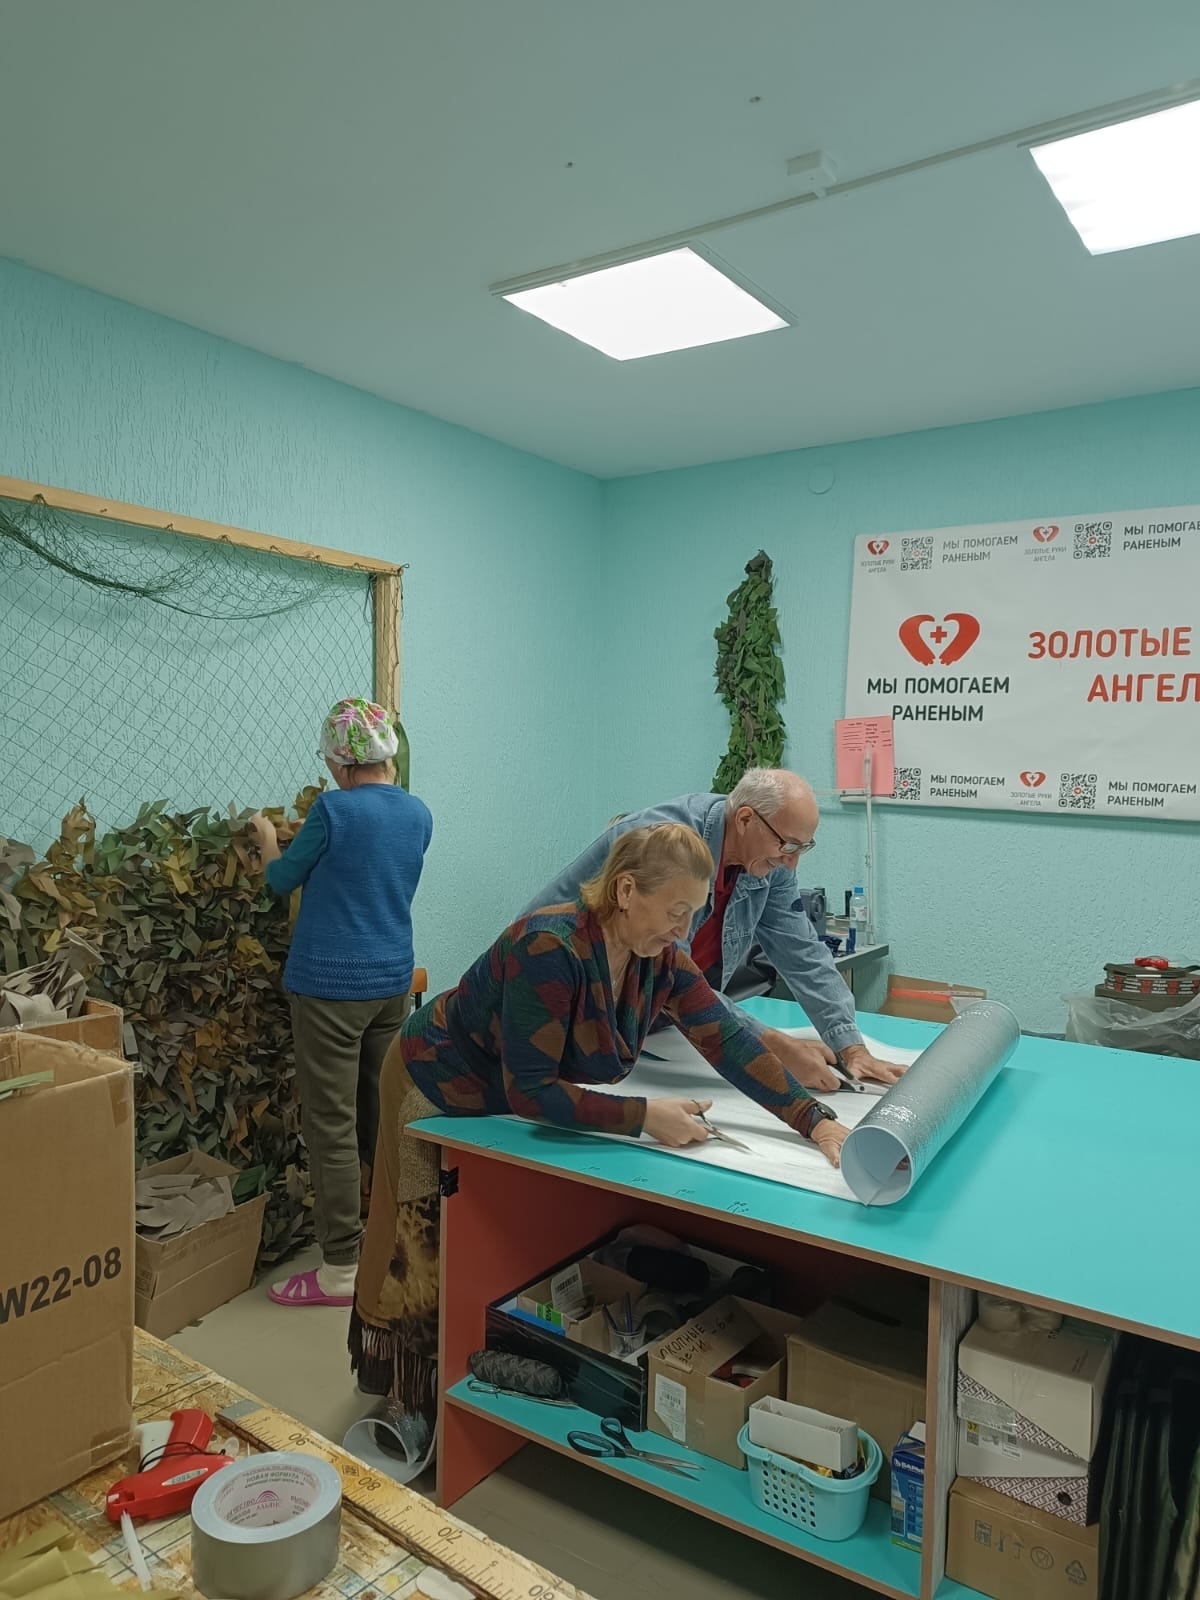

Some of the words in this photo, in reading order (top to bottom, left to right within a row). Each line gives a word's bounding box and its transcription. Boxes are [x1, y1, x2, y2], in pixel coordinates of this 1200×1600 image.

[1124, 525, 1143, 536] МЫ
[943, 540, 959, 550] МЫ
[963, 535, 1018, 548] ПОМОГАЕМ
[1123, 537, 1181, 550] РАНЕНЫМ
[942, 551, 991, 563] РАНЕНЫМ
[1027, 626, 1192, 659] ЗОЛОТЫЕ
[867, 677, 897, 694] МЫ
[905, 676, 1010, 694] ПОМОГАЕМ
[892, 705, 984, 722] РАНЕНЫМ
[930, 774, 947, 784] МЫ
[950, 775, 1005, 786] ПОМОГАЕМ
[930, 787, 977, 798] РАНЕНЫМ
[1108, 781, 1128, 791] МЫ
[1132, 782, 1197, 794] ПОМОГАЕМ
[1107, 795, 1164, 807] РАНЕНЫМ
[0, 1246, 121, 1324] W22-08
[358, 1477, 381, 1491] 80
[437, 1527, 463, 1544] 70
